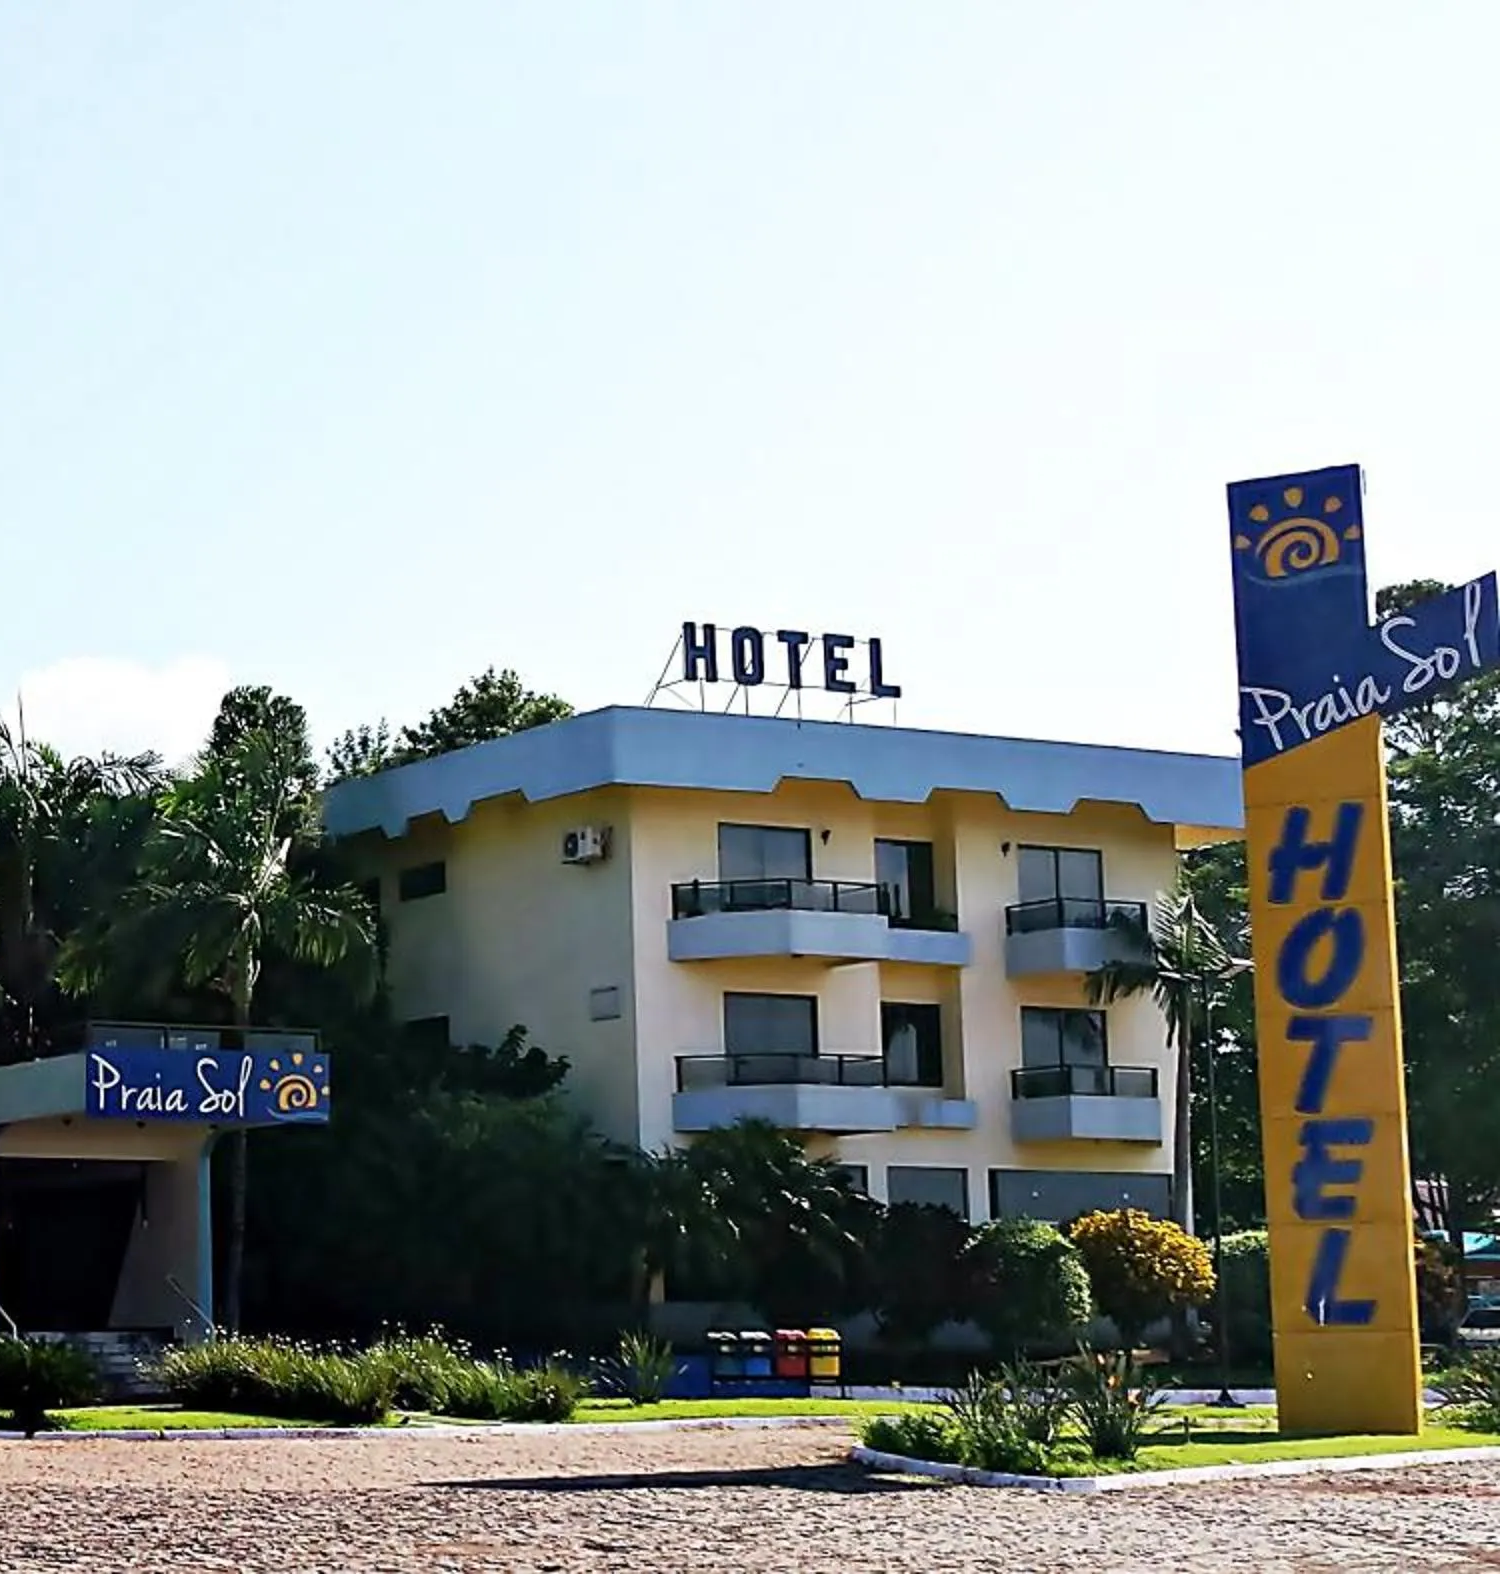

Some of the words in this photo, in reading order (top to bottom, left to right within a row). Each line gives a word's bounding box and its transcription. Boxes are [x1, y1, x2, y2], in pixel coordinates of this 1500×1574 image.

[682, 622, 901, 698] HOTEL
[1239, 674, 1391, 750] Praia
[1381, 582, 1481, 693] Sol
[91, 1053, 188, 1112] Praia
[196, 1055, 253, 1118] Sol
[1267, 801, 1377, 1326] HOTEL
